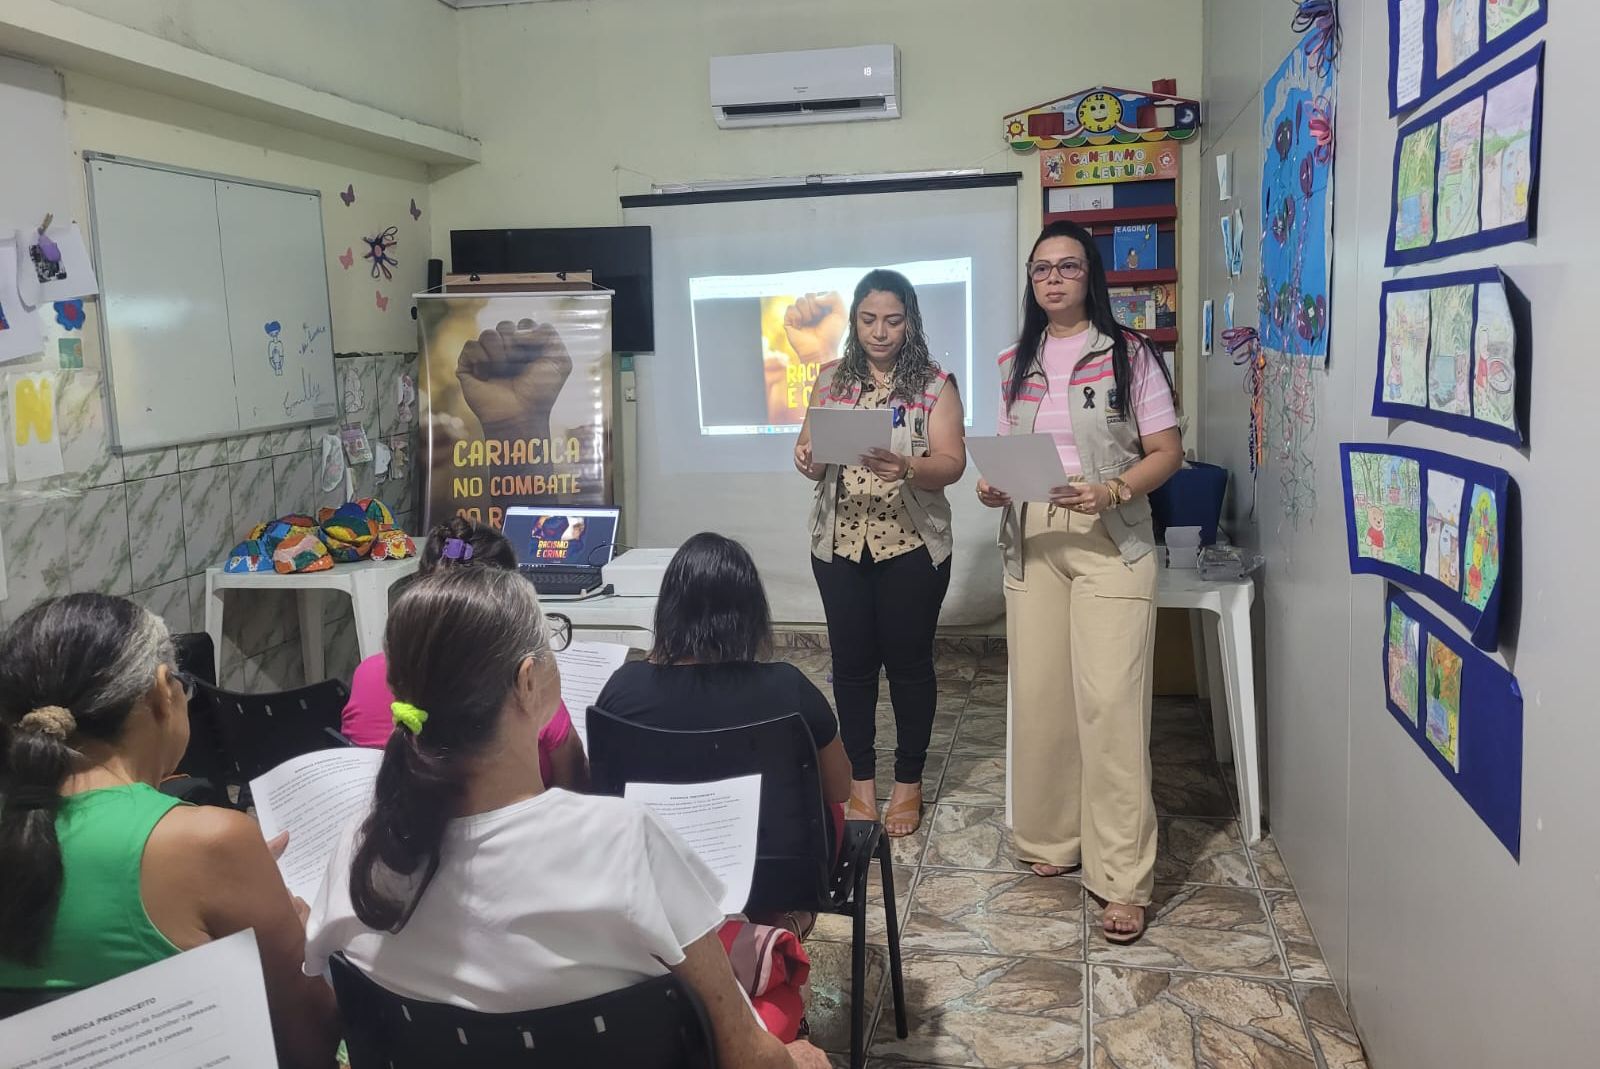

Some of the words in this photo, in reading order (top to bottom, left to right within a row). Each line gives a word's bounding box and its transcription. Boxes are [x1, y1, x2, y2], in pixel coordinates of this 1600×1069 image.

[1092, 162, 1156, 180] LEITURA
[787, 363, 820, 383] RACI
[787, 384, 797, 409] É
[453, 437, 580, 467] CARIACICA
[453, 477, 483, 498] NO
[490, 473, 581, 497] COMBATE
[542, 549, 568, 559] CRIME
[97, 997, 156, 1024] PRECONCEITO
